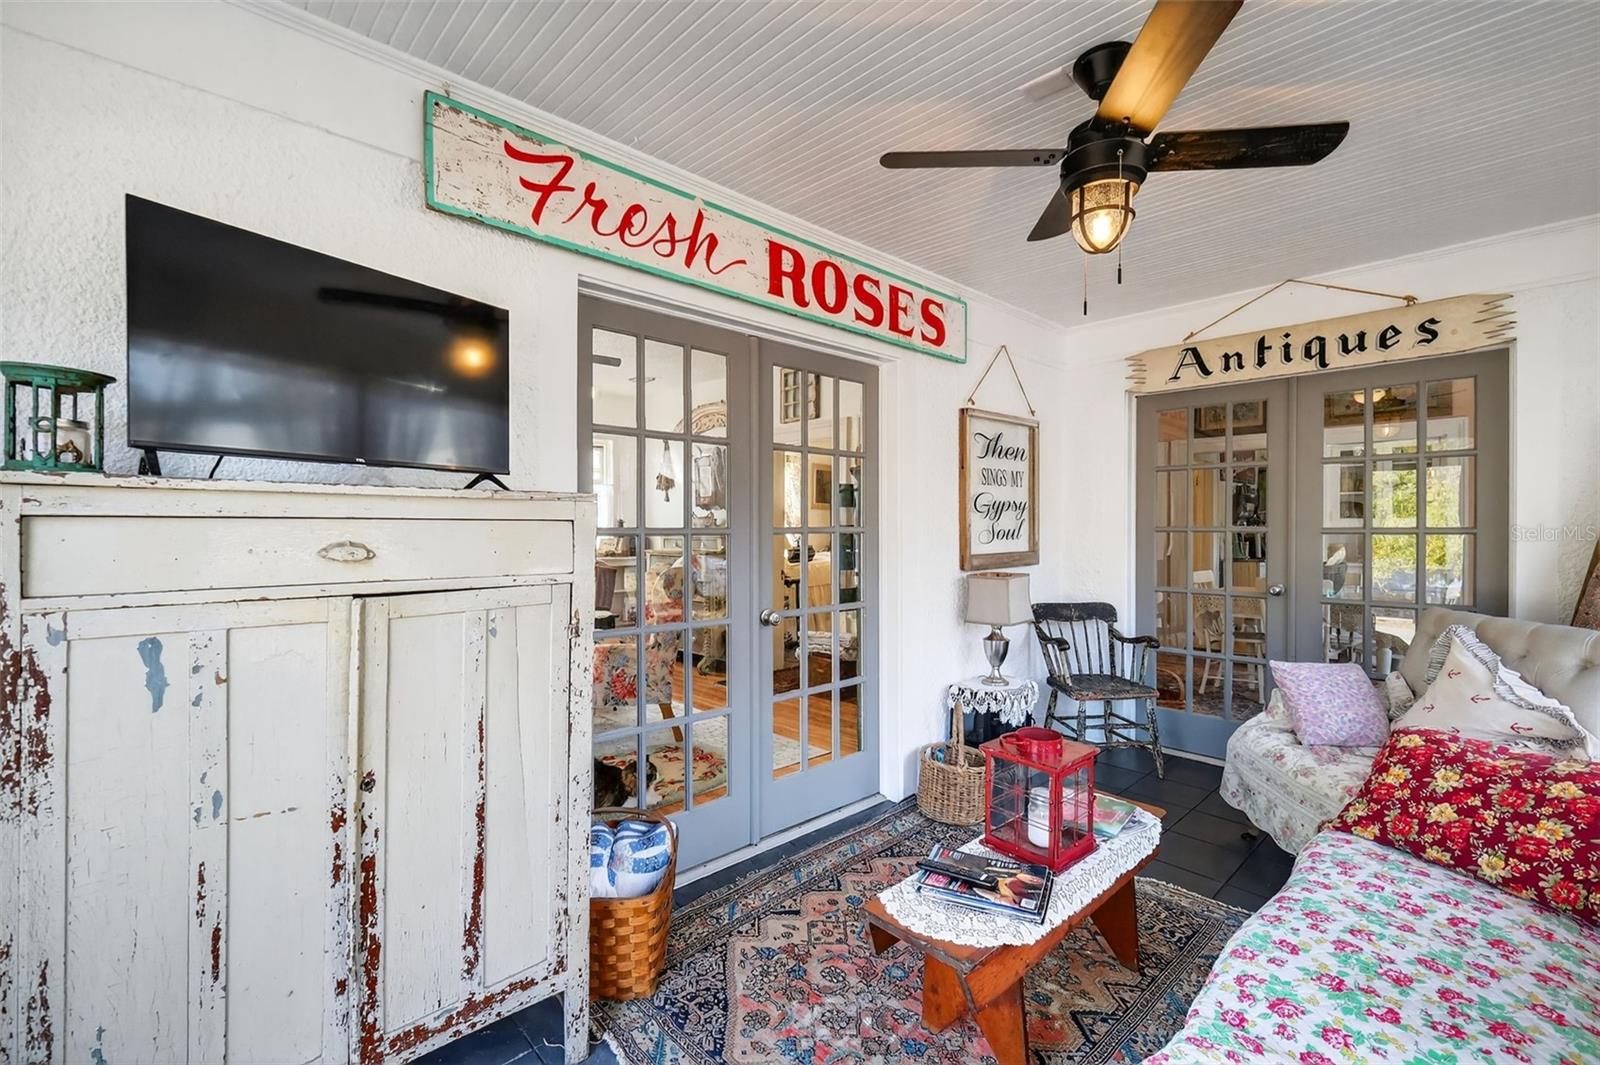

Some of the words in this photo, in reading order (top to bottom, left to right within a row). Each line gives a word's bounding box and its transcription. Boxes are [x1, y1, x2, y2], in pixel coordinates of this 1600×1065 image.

[503, 140, 747, 275] Fresh
[766, 239, 948, 348] ROSES
[1167, 316, 1442, 382] Antiques
[974, 432, 1027, 461] Then
[981, 467, 1008, 487] SINGS
[1010, 470, 1025, 488] MY
[973, 492, 1028, 521] Gypsy
[978, 518, 1026, 545] Soul
